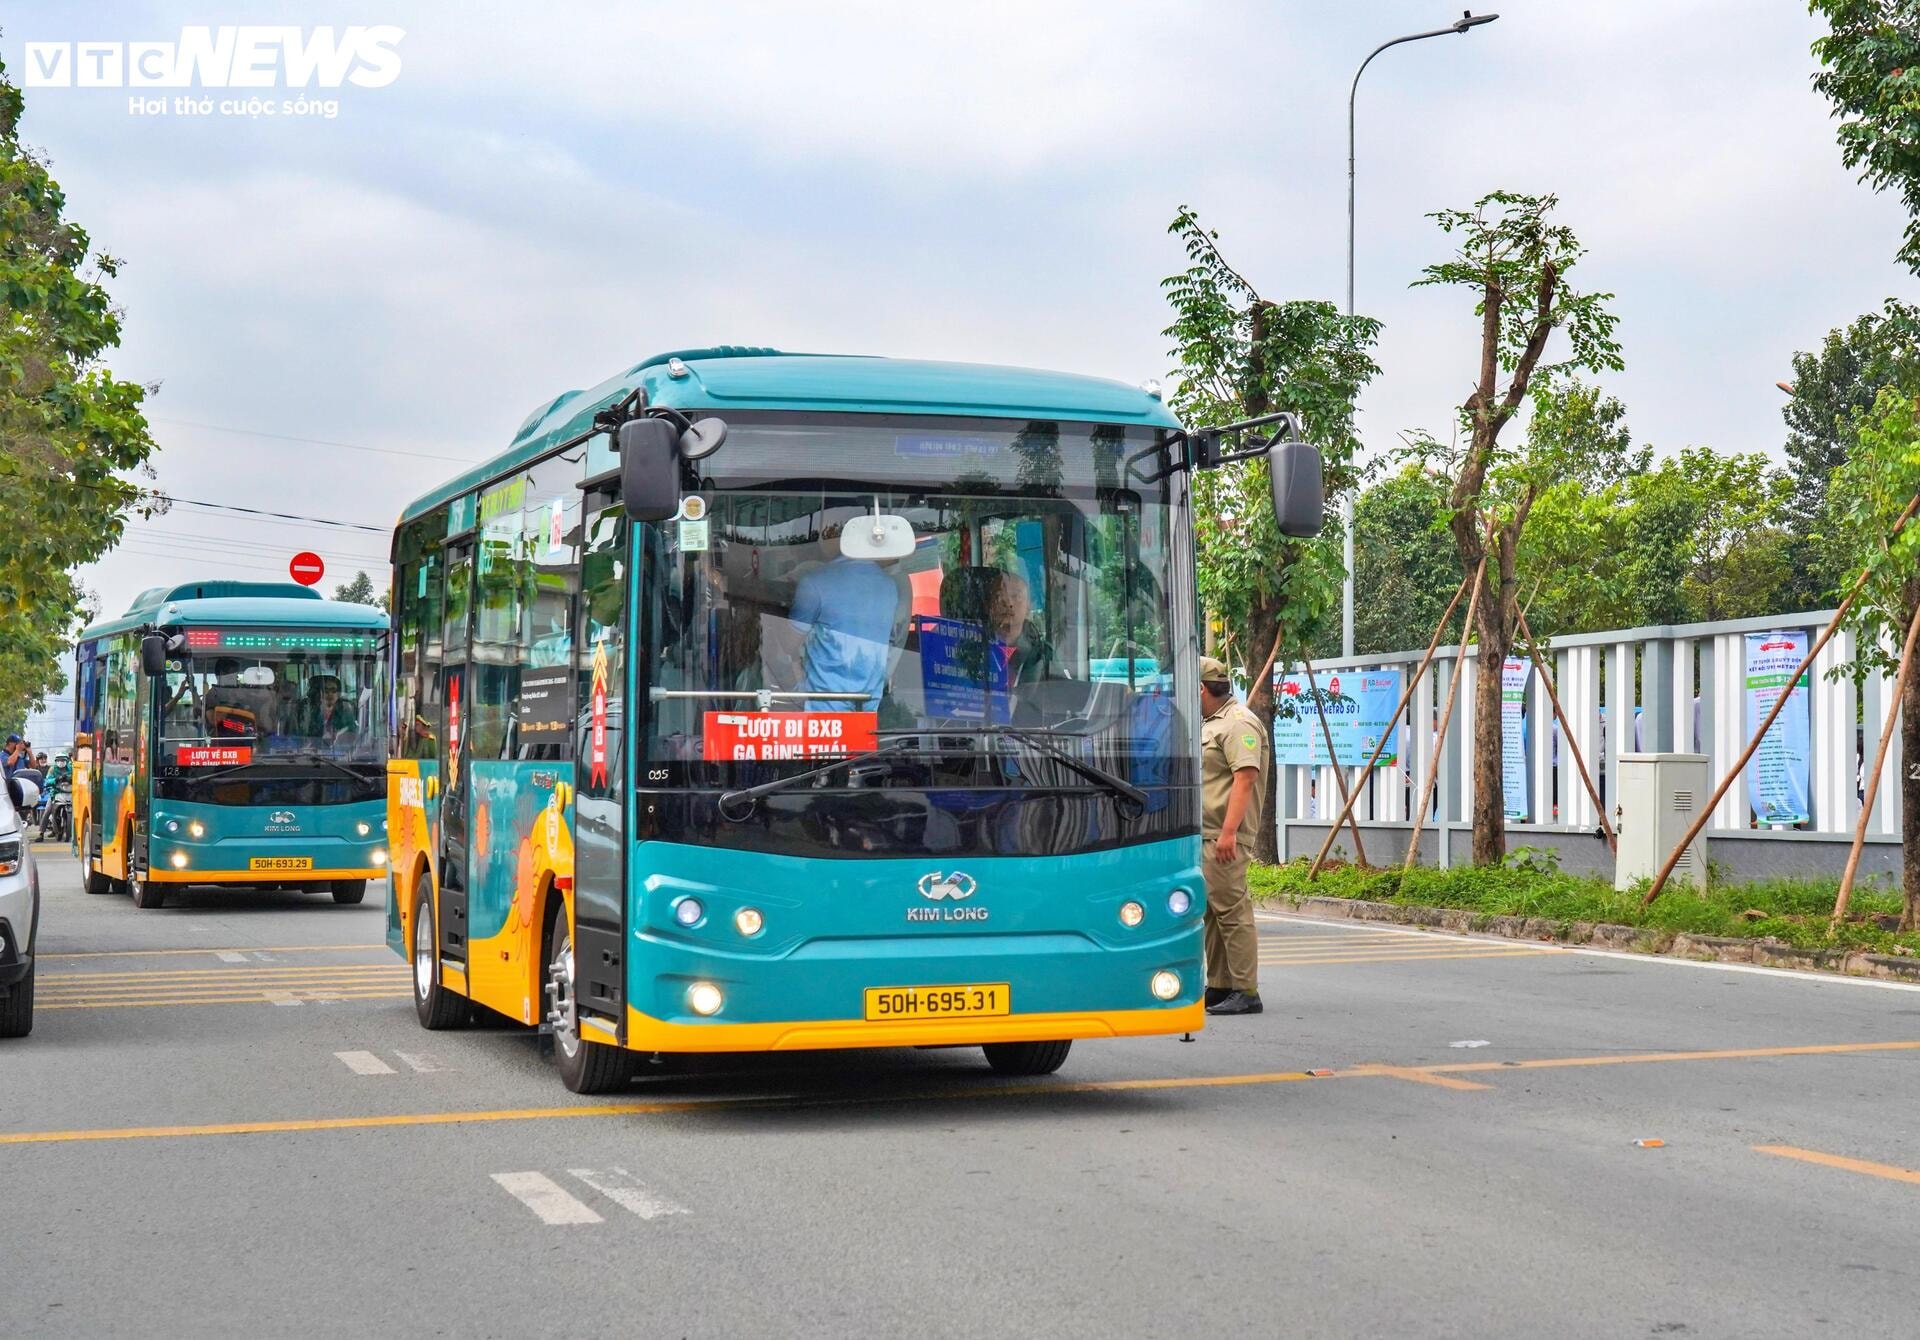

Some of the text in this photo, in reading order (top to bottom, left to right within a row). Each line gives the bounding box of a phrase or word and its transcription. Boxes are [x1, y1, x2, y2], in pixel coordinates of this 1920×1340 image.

[1324, 704, 1344, 714] METRO
[738, 717, 843, 741] LƯỢT ĐI BXB
[222, 751, 238, 759] BXB
[733, 744, 757, 760] GA
[761, 741, 804, 760] BÌNH
[254, 859, 308, 869] 50H-693.29
[907, 907, 989, 921] KIM LONG
[878, 990, 996, 1014] 50H-695.31
